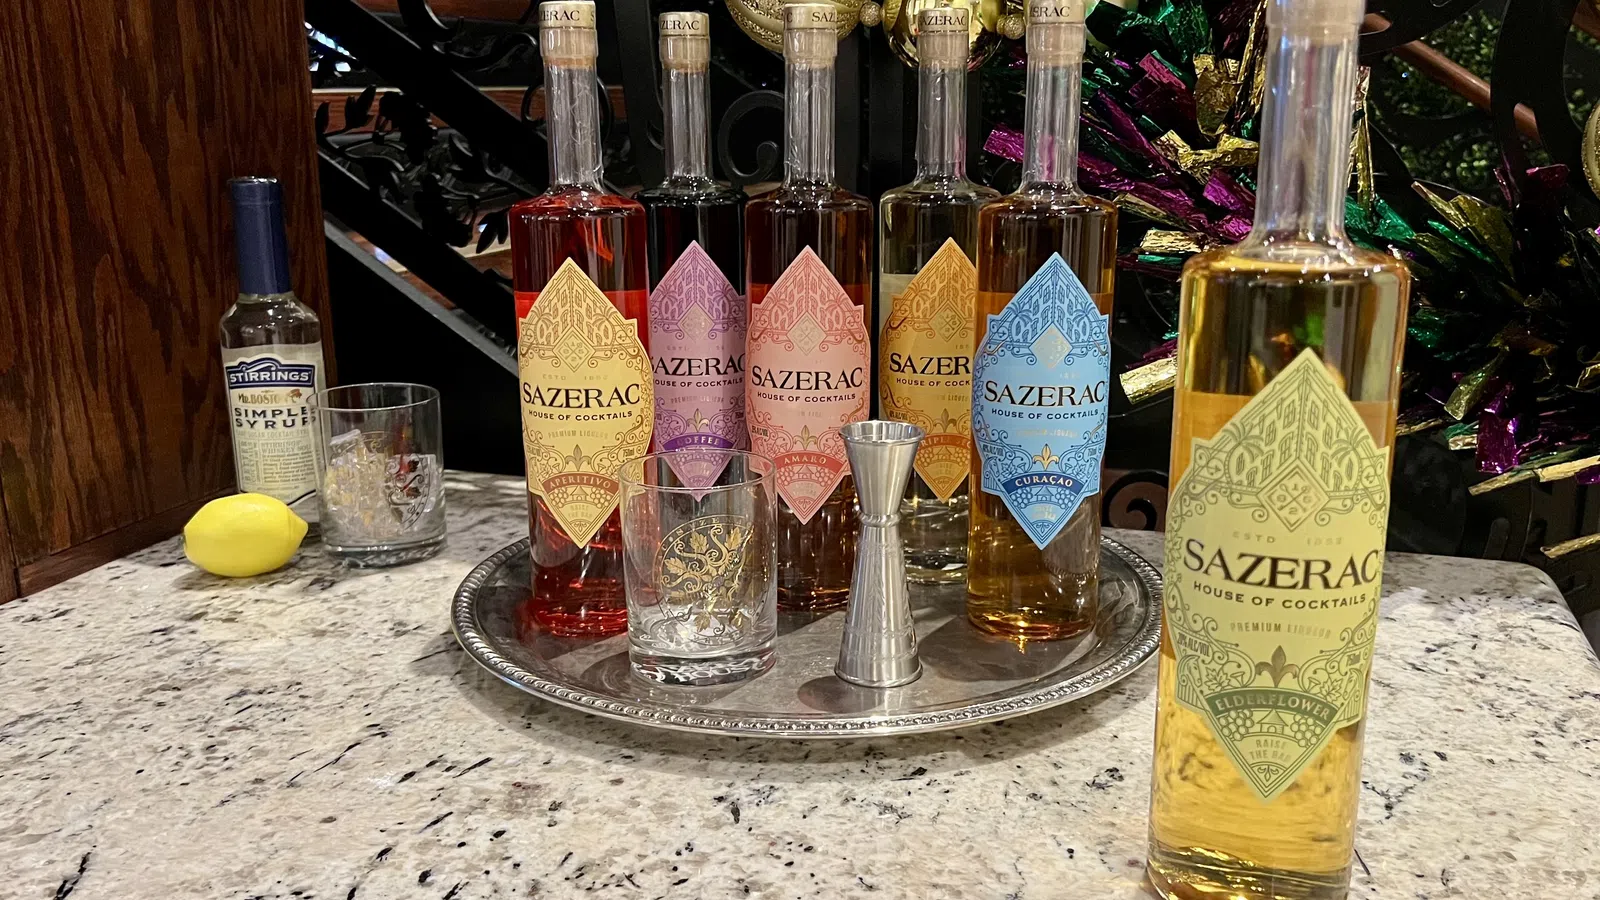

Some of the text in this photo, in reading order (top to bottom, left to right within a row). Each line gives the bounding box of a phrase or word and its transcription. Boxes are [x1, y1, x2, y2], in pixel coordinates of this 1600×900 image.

[540, 10, 580, 21] ERAC
[1031, 6, 1070, 17] ERAC
[650, 354, 745, 376] AZERAC
[229, 371, 309, 383] STIRRINGS
[654, 379, 677, 387] OUSE
[696, 378, 743, 388] COCKTAILS
[751, 366, 863, 390] SAZERAC
[897, 378, 925, 386] HOUSE
[523, 382, 640, 408] SAZERAC
[758, 392, 785, 401] HOUSE
[804, 393, 856, 403] COCKTAILS
[984, 380, 1105, 407] SAZERAC
[234, 405, 309, 419] SIMPLE
[529, 409, 555, 419] HOUSE
[575, 410, 633, 421] COCKTAILS
[992, 408, 1024, 419] HOUSE
[1047, 409, 1099, 420] COCKTAILS
[784, 455, 827, 464] AMARO
[549, 475, 611, 490] APERITIVO
[1015, 475, 1073, 487] CURAÇAO
[1183, 539, 1379, 590] SAZERAC
[1193, 580, 1366, 610] HOUSE OF COCKTAILS
[1230, 621, 1282, 633] PREMIUM
[1215, 691, 1330, 720] ELDERFLOWER
[1249, 749, 1268, 760] THE
